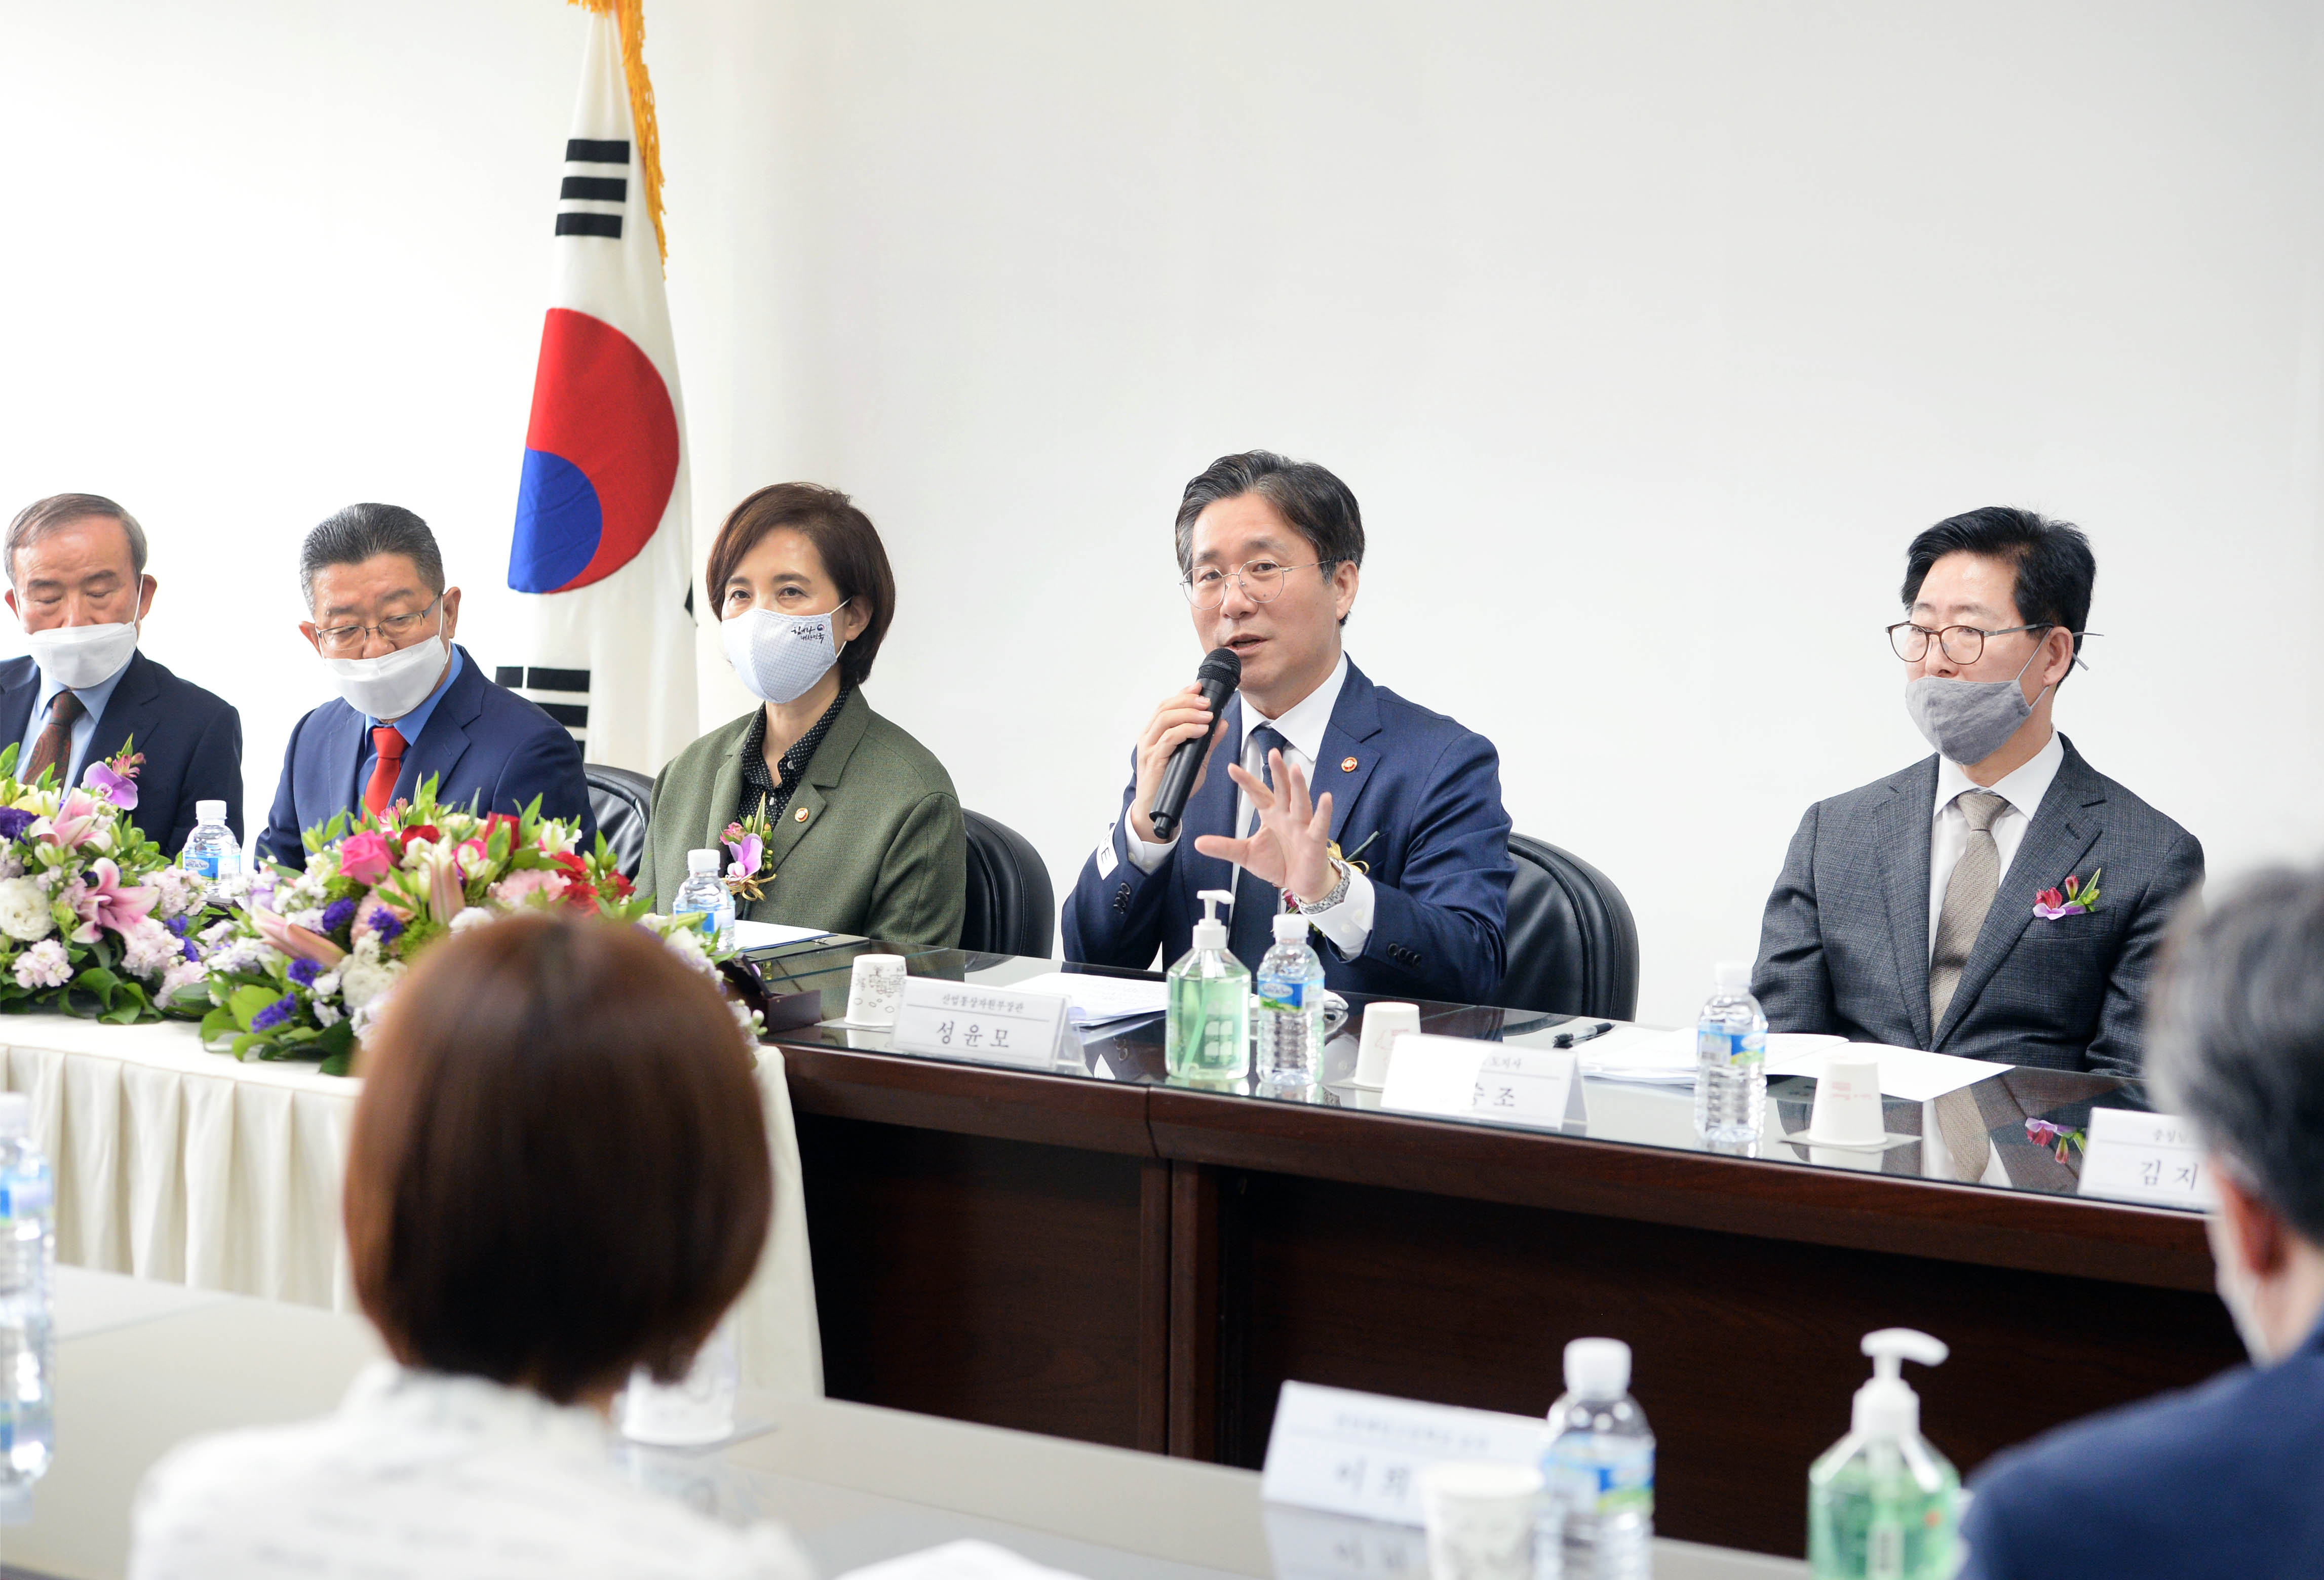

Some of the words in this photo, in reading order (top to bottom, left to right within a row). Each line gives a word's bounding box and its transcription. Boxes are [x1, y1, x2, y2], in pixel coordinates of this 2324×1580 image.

[791, 625, 816, 635] 힘내라
[800, 633, 825, 644] 대한민국
[943, 994, 1025, 1013] 산업통상자원부장관
